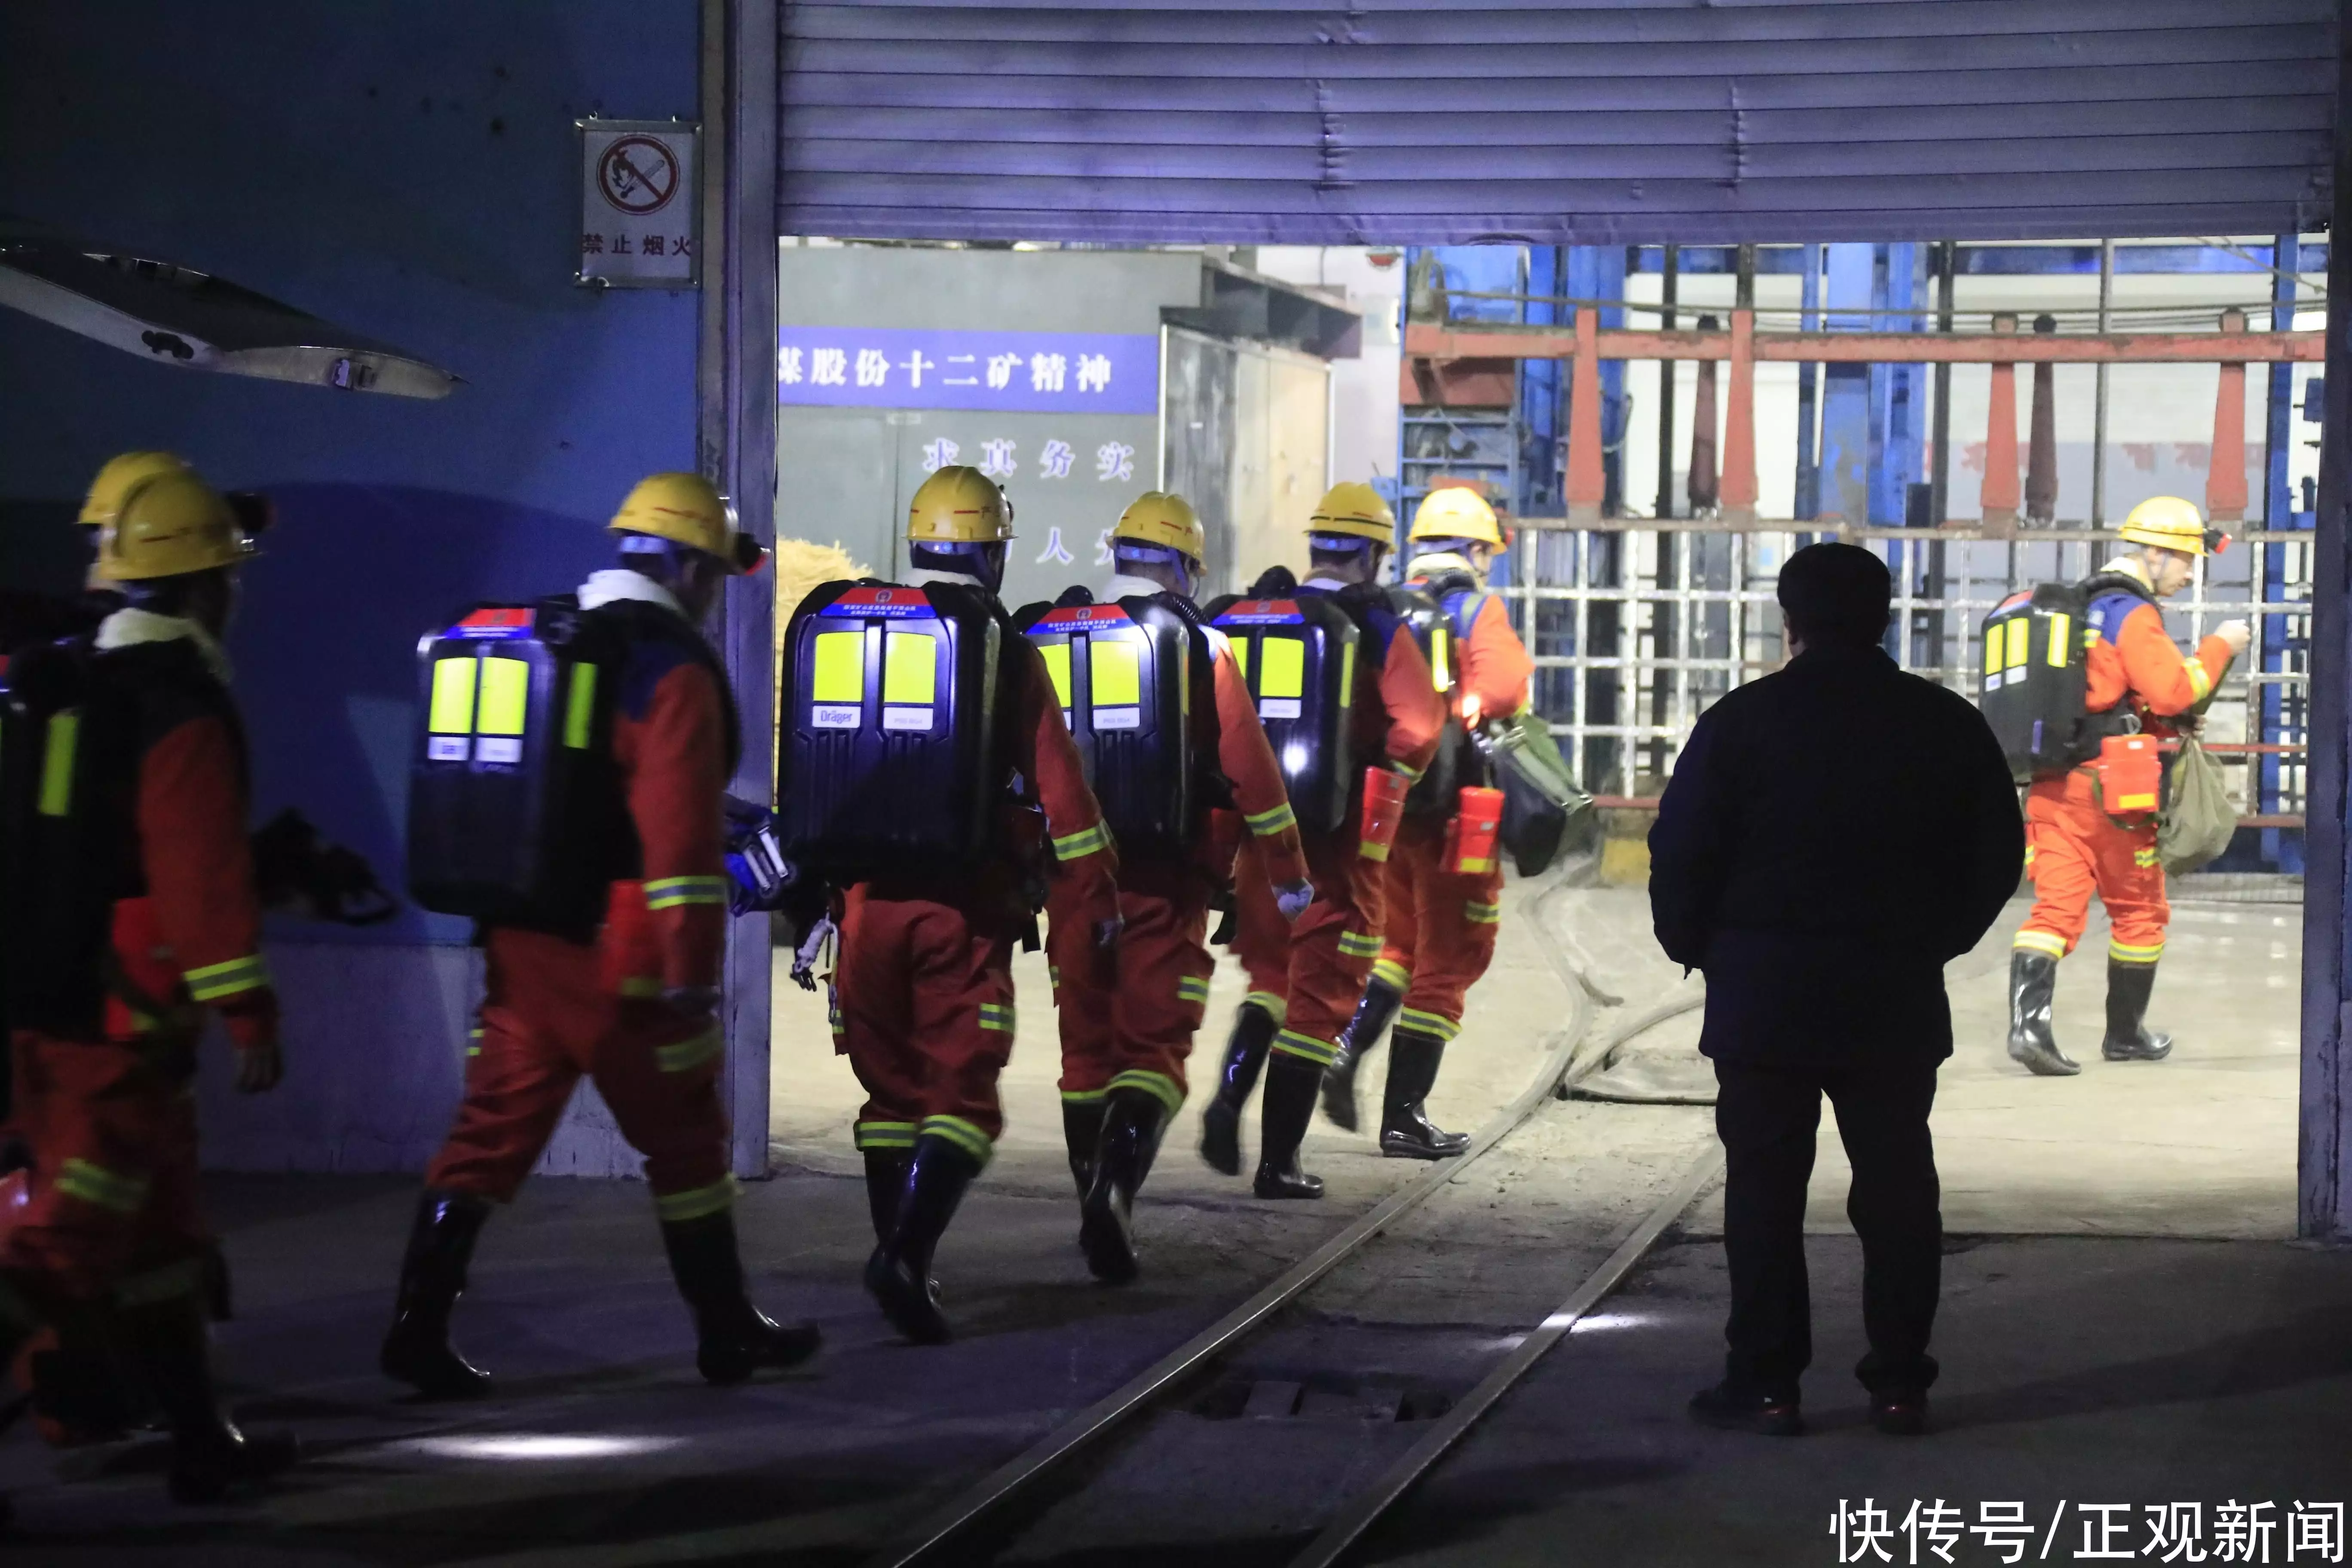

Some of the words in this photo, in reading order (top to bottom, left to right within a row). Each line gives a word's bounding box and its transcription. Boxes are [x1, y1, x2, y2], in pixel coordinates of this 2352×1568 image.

[582, 233, 692, 256] 禁止烟火
[922, 438, 1134, 482] 求真务实
